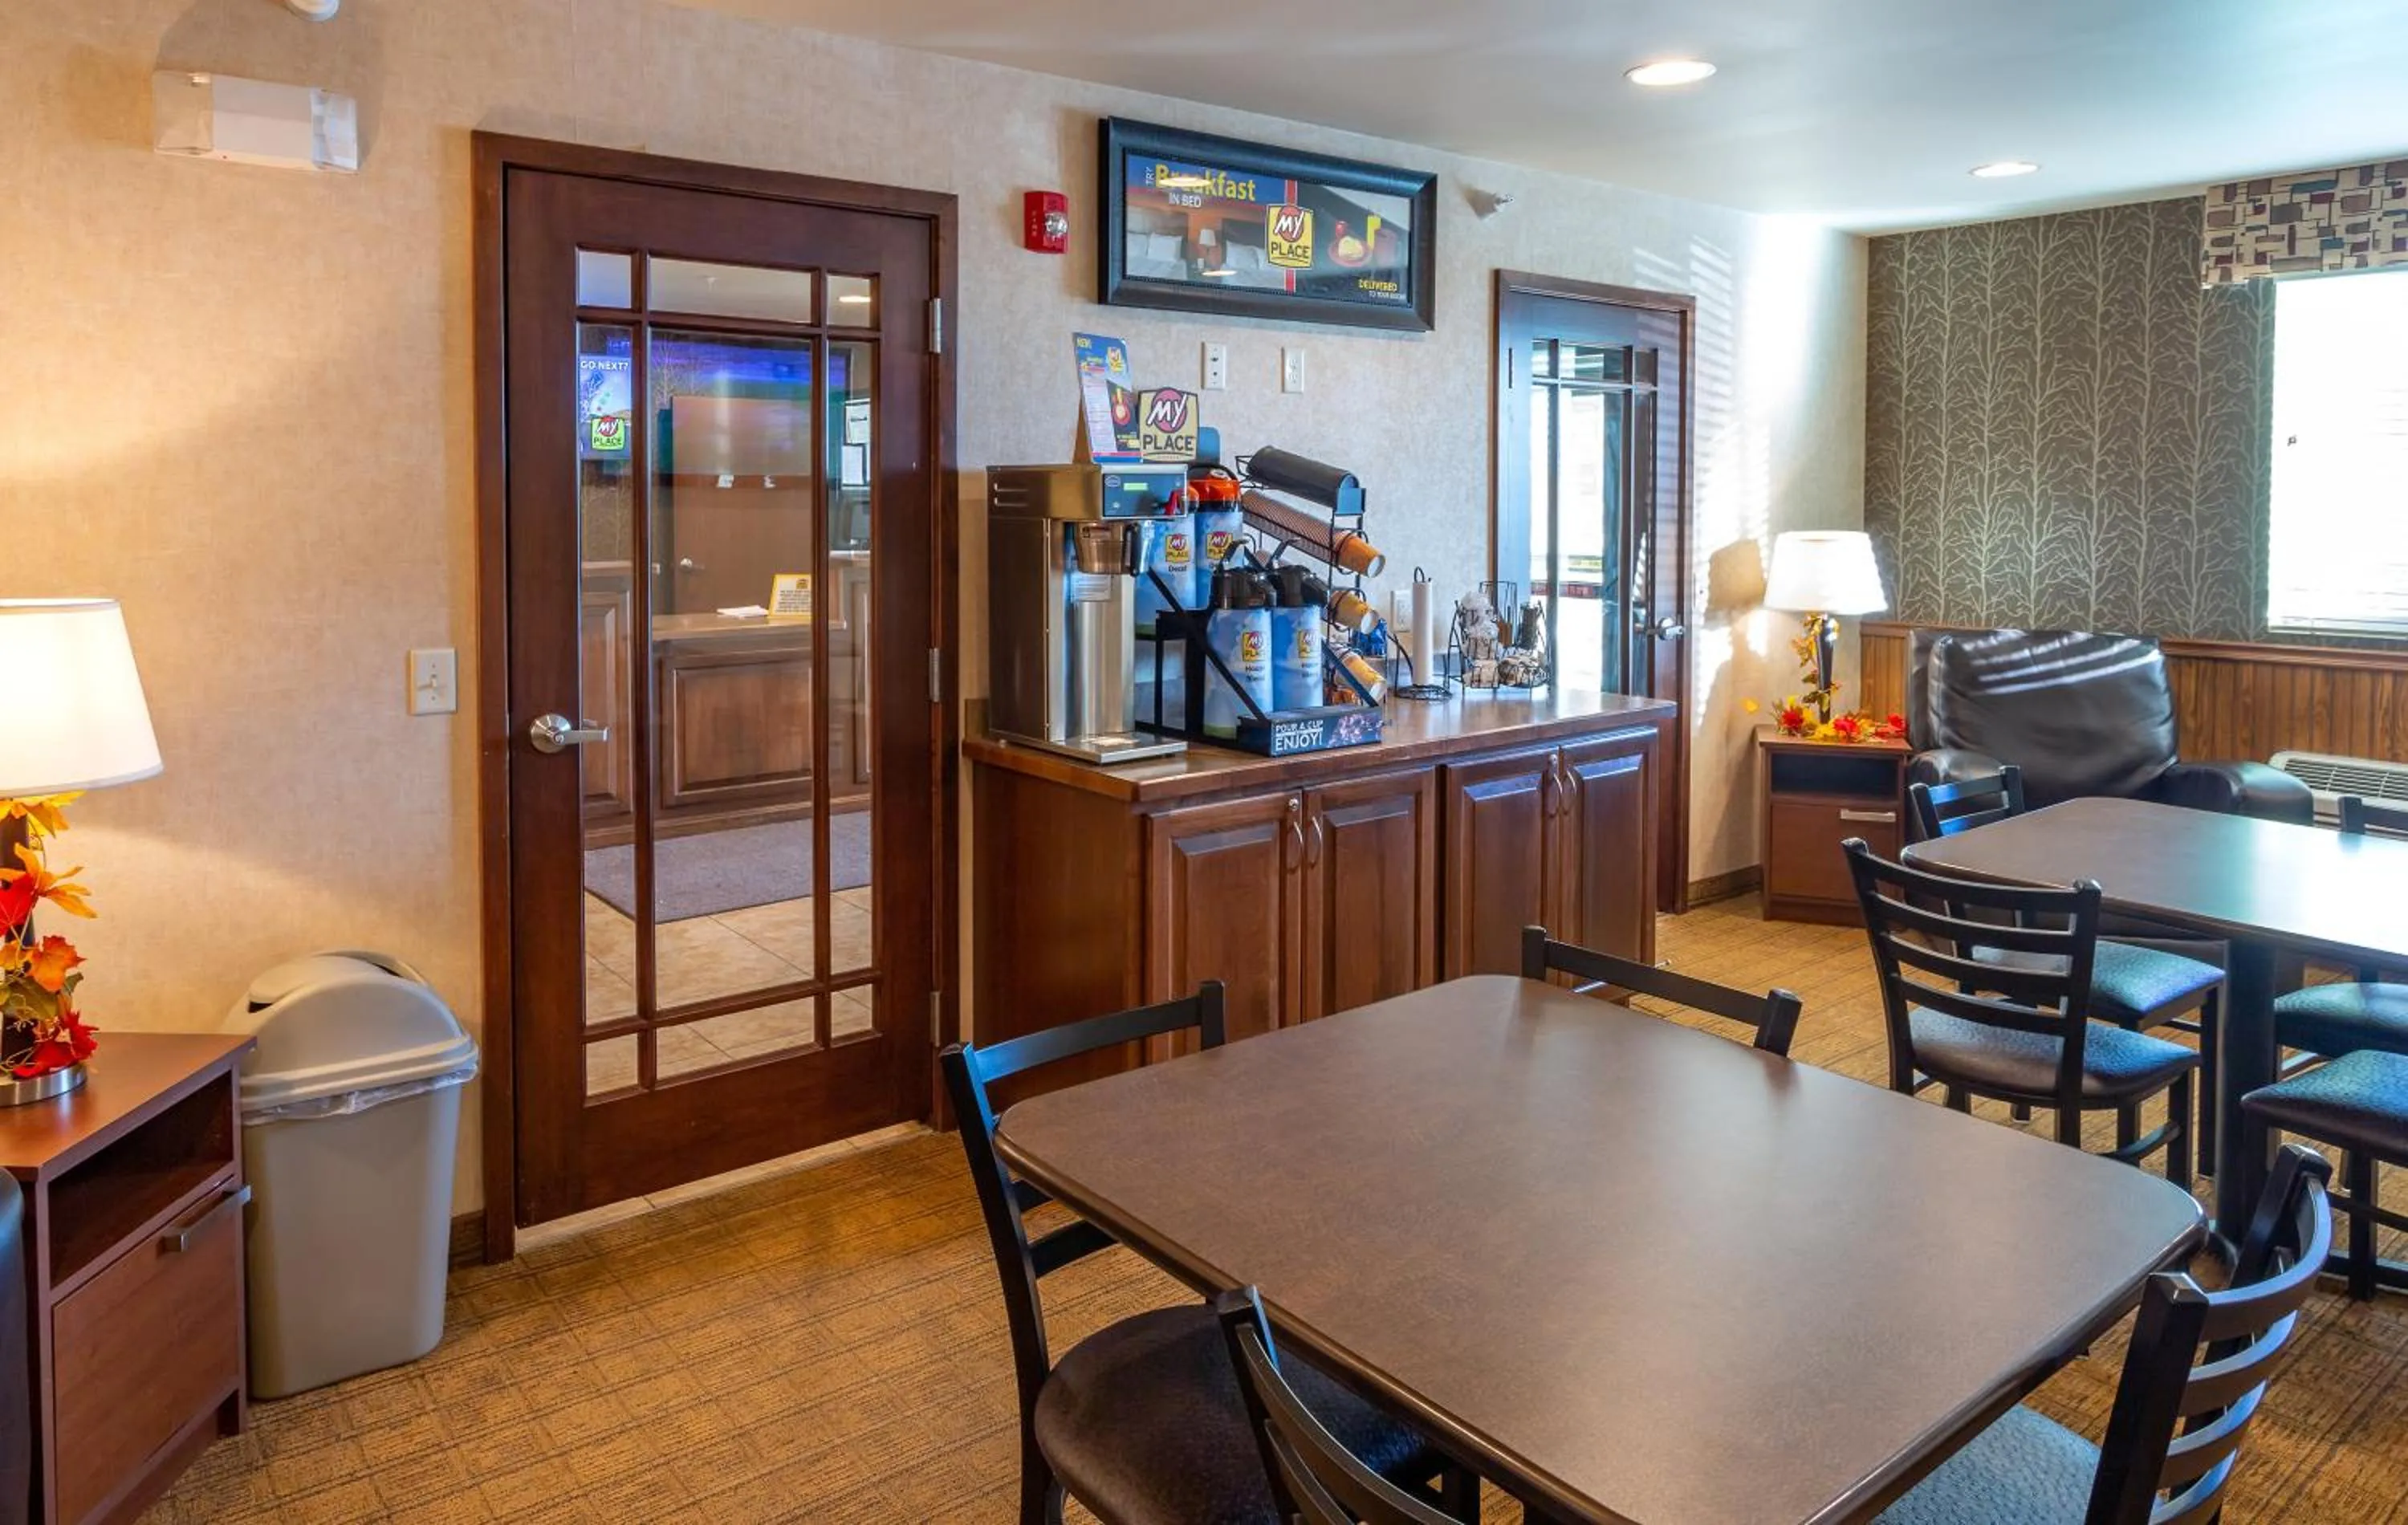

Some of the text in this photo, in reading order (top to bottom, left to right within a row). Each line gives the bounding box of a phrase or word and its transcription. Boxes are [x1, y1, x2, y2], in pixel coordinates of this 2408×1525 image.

[1169, 192, 1202, 208] IN BED
[1271, 242, 1311, 259] PLACE
[580, 360, 629, 371] GO NEXT?
[594, 436, 623, 445] PLACE
[1142, 434, 1194, 451] PLACE
[1275, 719, 1324, 733] POUR A CUP
[1275, 731, 1323, 751] ENJOY!
